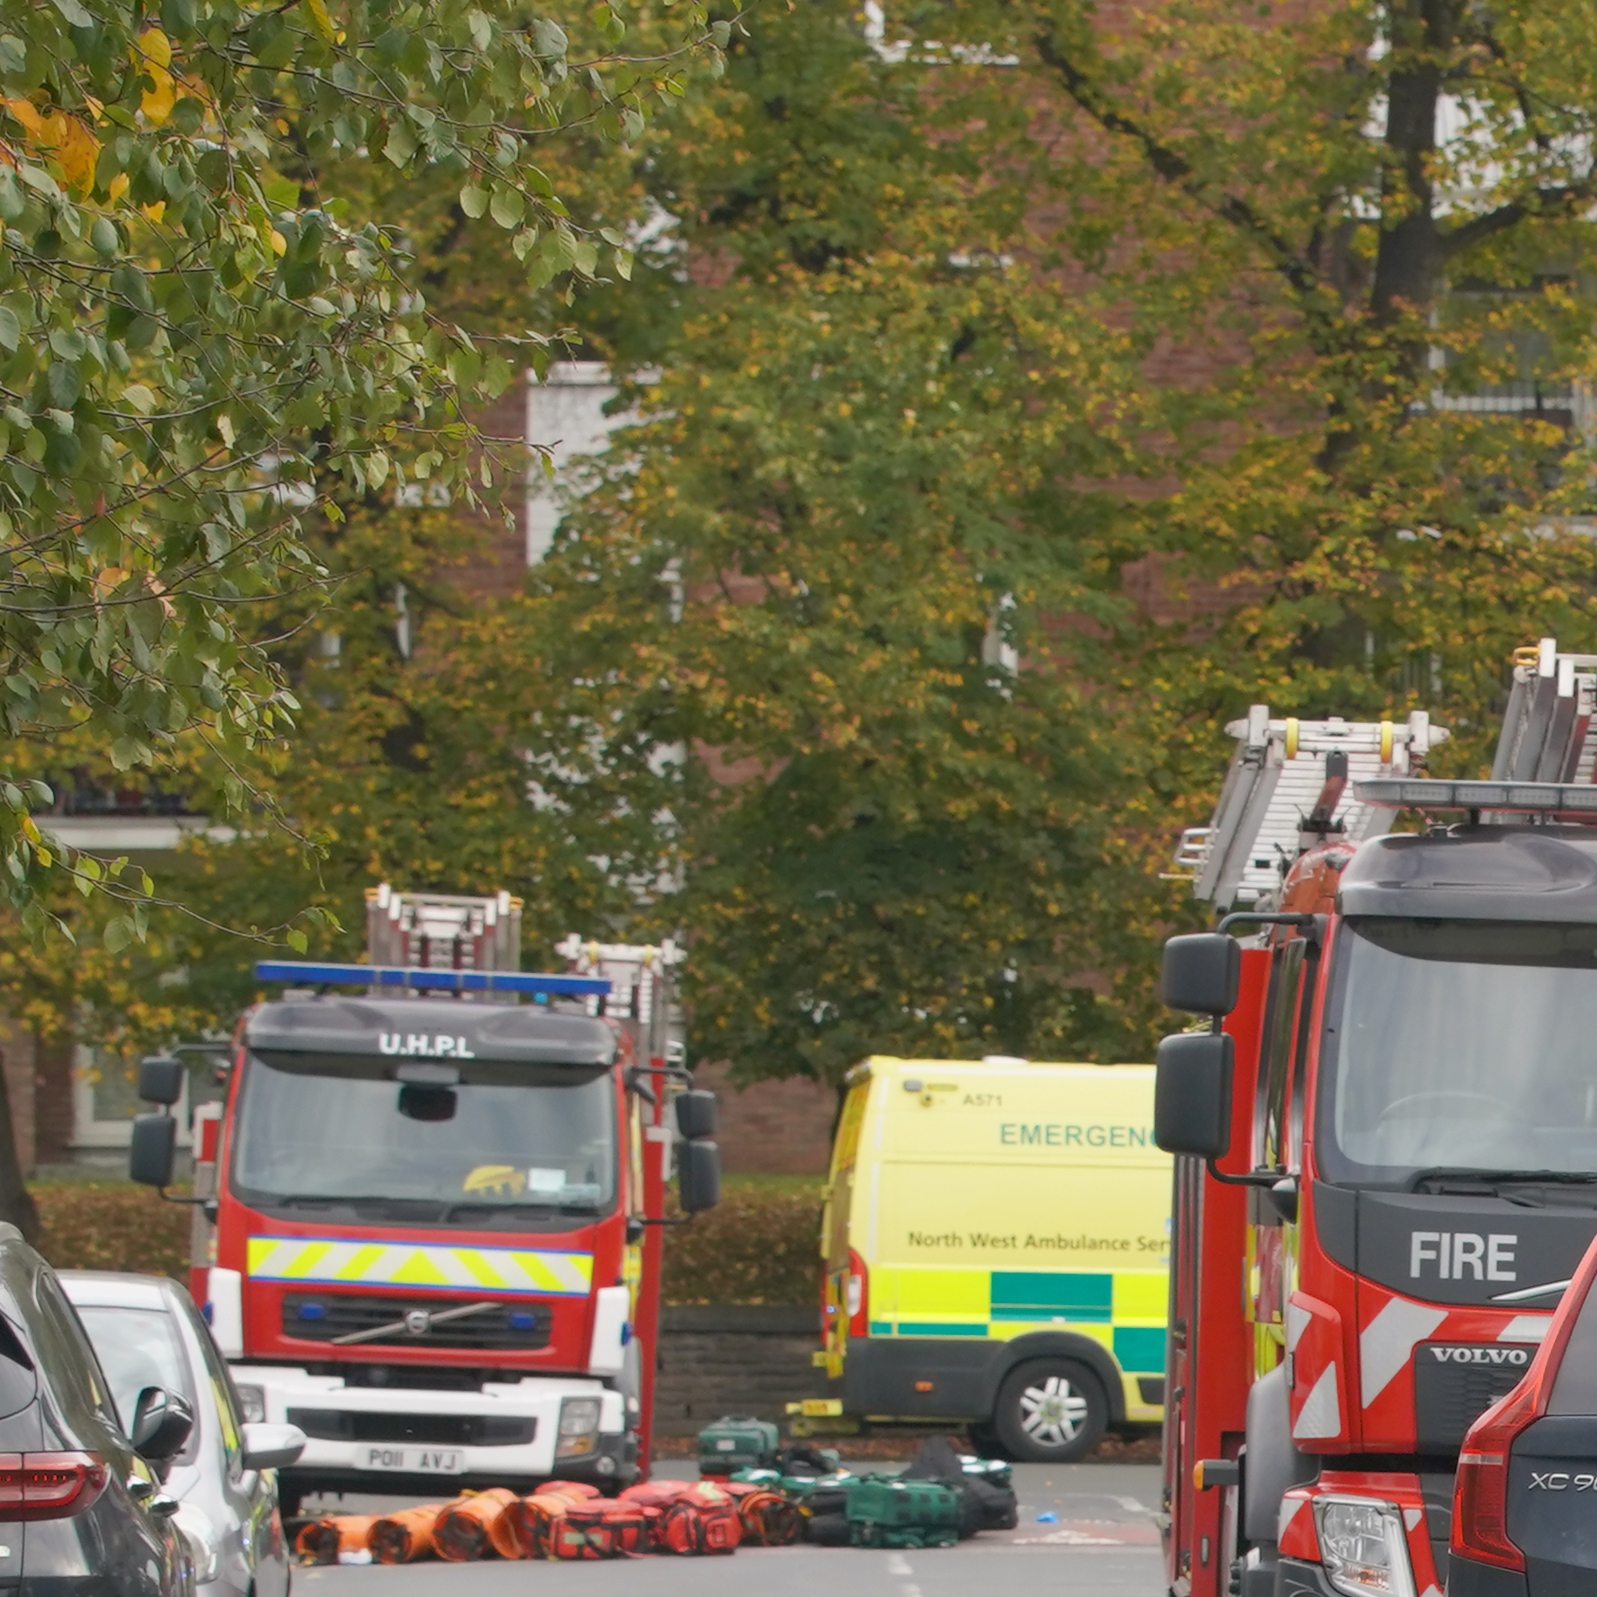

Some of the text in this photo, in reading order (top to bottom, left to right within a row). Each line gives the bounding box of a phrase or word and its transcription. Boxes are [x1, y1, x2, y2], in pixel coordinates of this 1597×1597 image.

[908, 1231, 963, 1248] North
[970, 1232, 1018, 1249] West
[1024, 1233, 1131, 1252] Ambulance
[1410, 1231, 1518, 1281] FIRE
[1430, 1347, 1528, 1365] VOLVO
